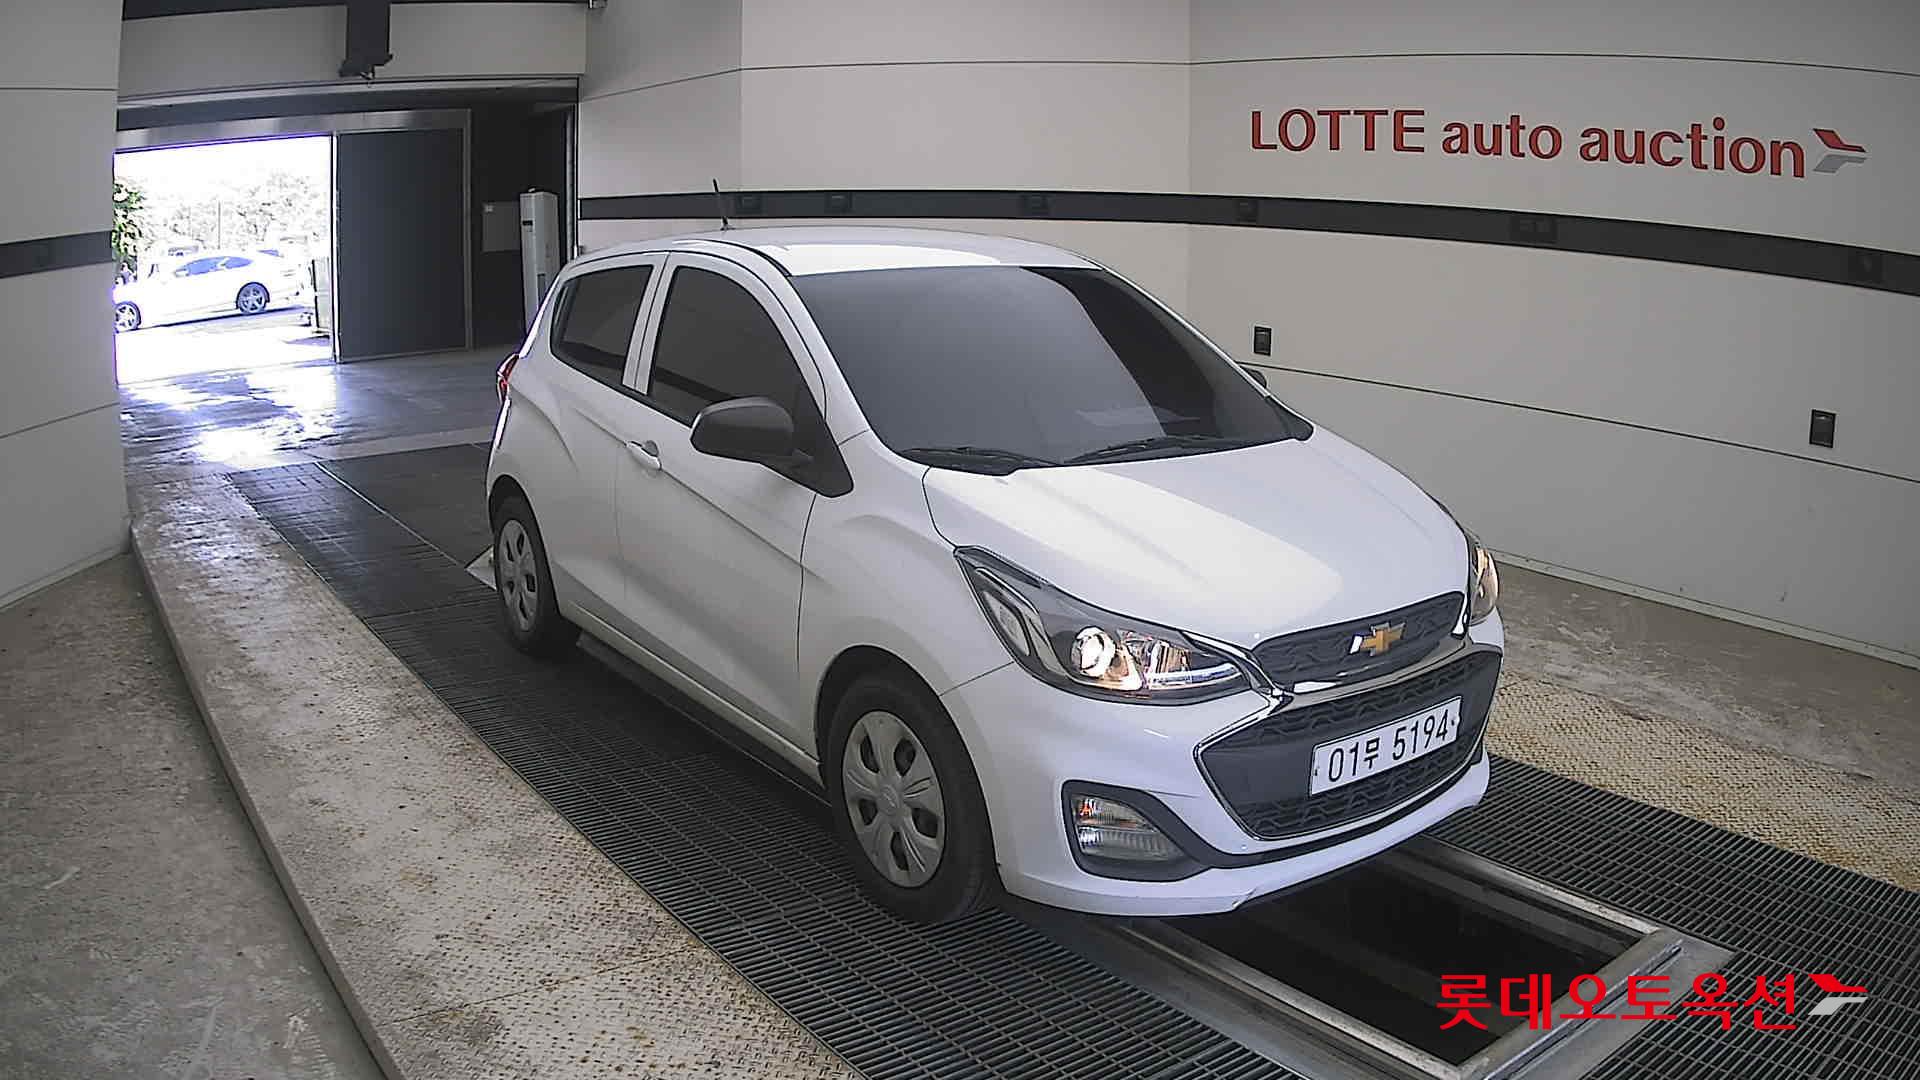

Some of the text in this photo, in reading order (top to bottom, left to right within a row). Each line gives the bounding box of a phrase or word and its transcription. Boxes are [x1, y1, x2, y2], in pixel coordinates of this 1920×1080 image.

[1251, 109, 1805, 178] LOTTE auto auction
[1328, 708, 1449, 783] 01무 5194
